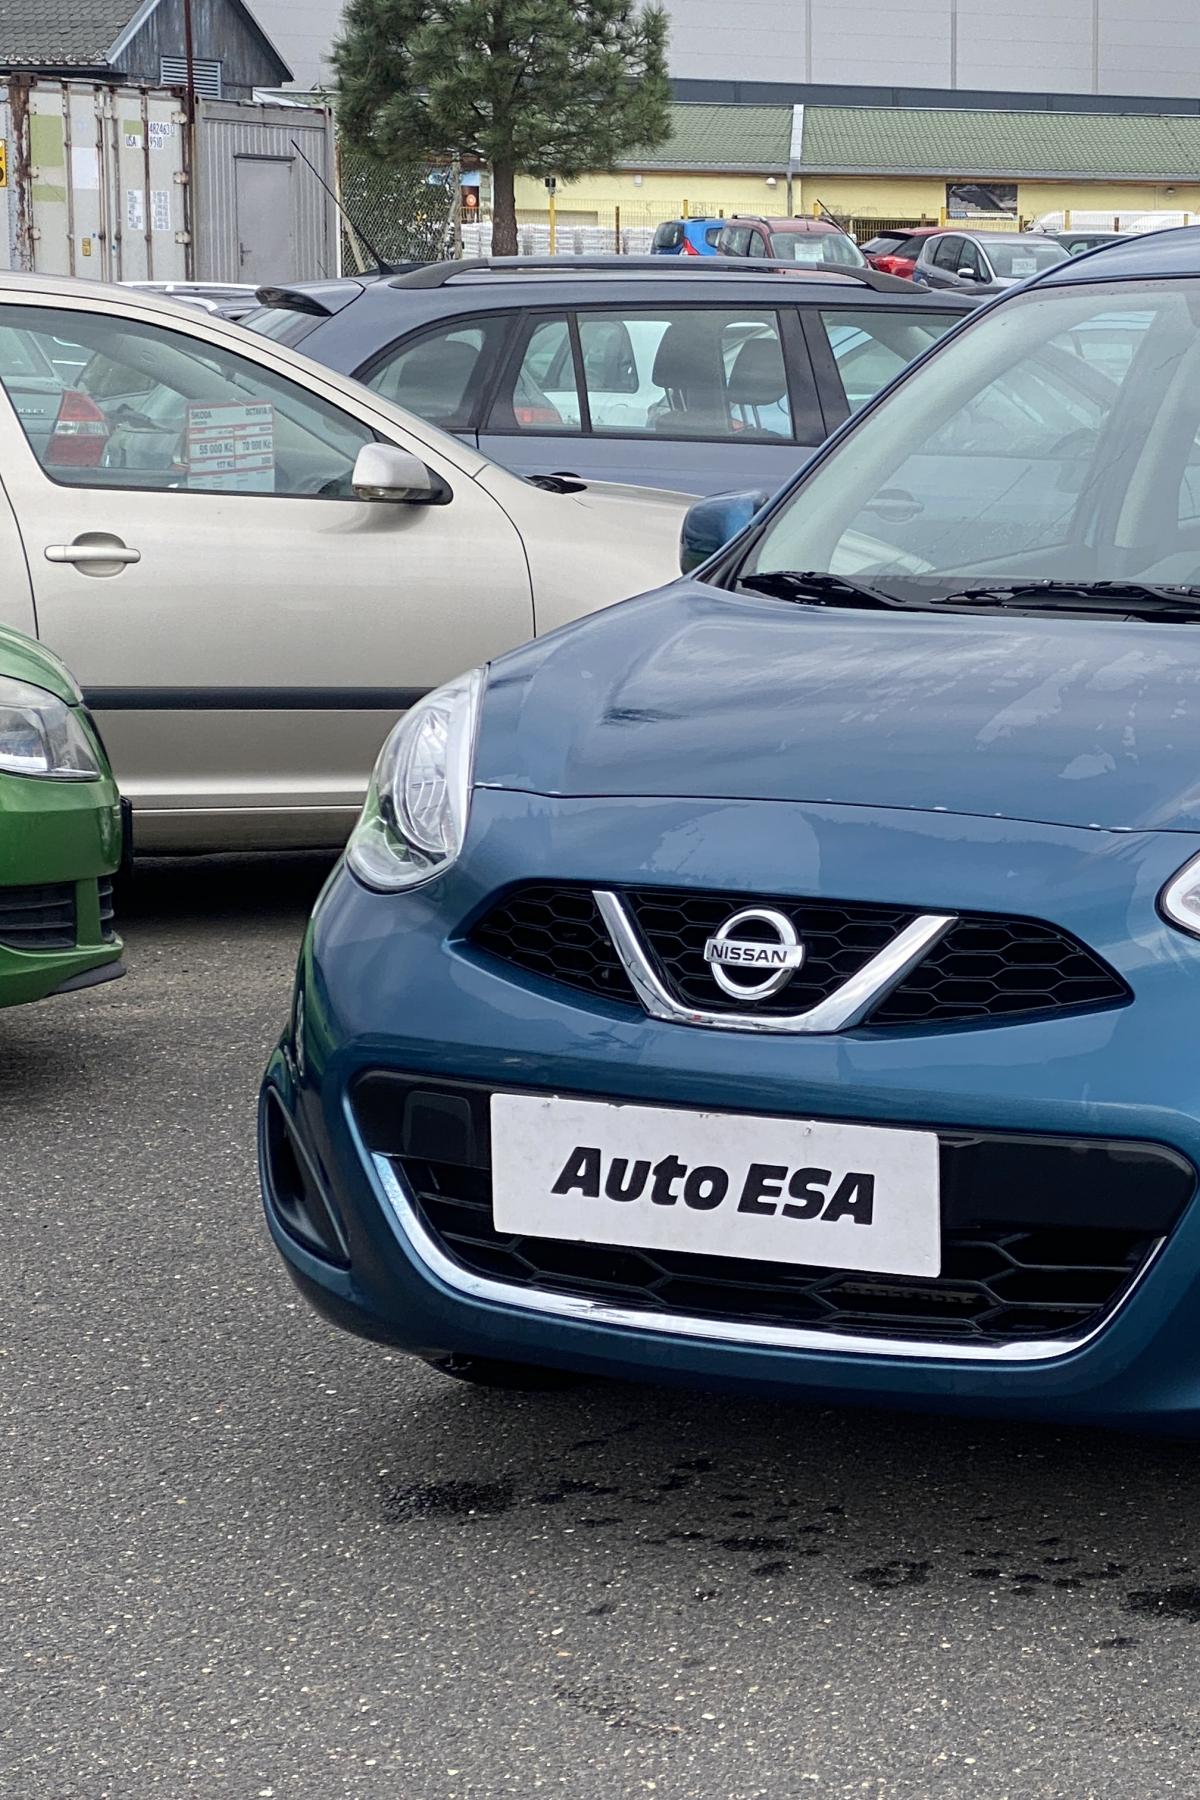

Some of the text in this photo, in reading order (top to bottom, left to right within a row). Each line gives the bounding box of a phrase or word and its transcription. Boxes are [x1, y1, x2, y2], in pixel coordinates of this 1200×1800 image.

[710, 944, 788, 964] NISSAN
[551, 1146, 876, 1226] Auto ESA
